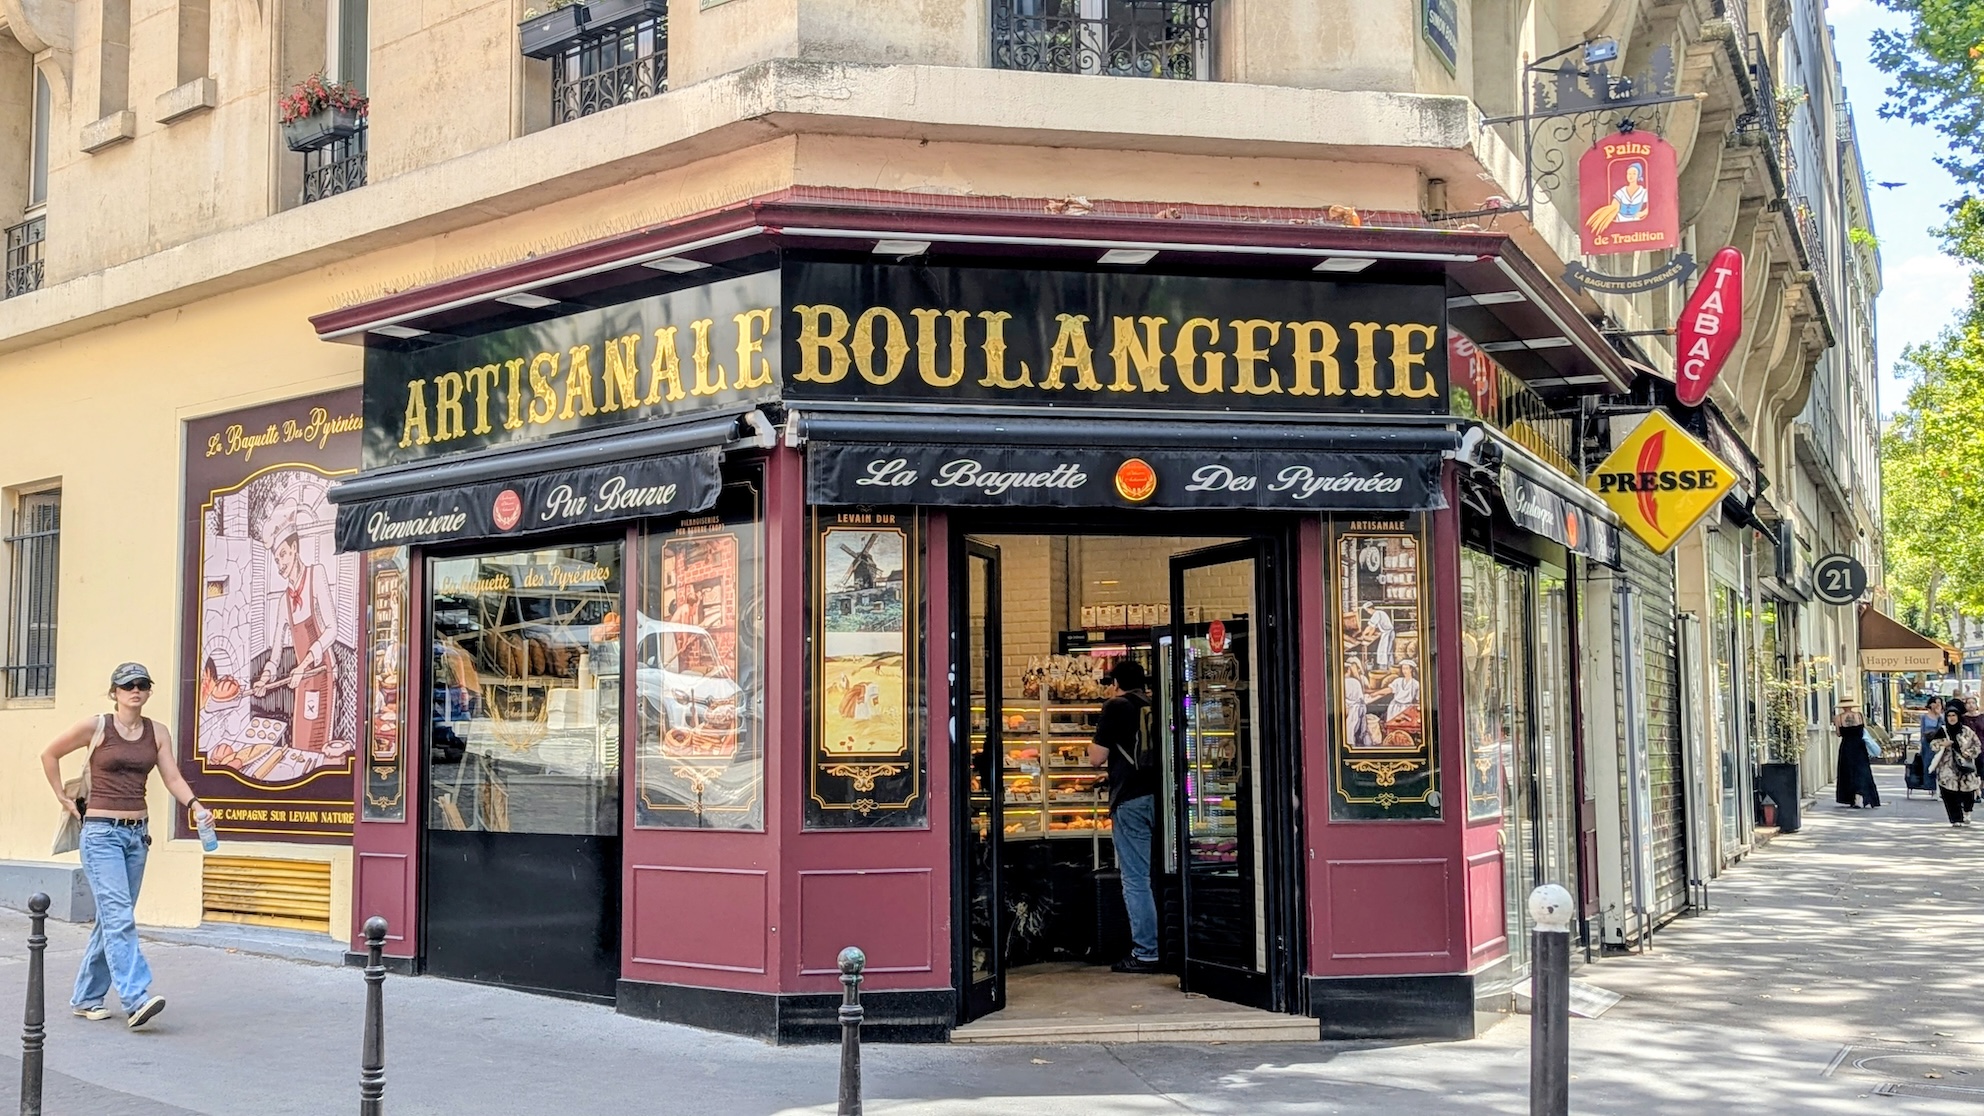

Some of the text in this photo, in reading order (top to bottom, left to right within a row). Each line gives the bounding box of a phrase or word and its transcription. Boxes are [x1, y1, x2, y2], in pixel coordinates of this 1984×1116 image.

[1603, 141, 1651, 159] Pains
[1593, 231, 1664, 246] de Tradition
[1574, 271, 1585, 281] LA
[1585, 276, 1626, 289] BAGUETTE
[1626, 280, 1643, 288] DES
[1684, 268, 1732, 381] TABAC
[791, 303, 1440, 399] BOULANGERIE
[399, 307, 773, 448] ARTISANALE
[206, 407, 364, 462] La Baguette Des Pyrénées
[856, 458, 918, 487] La
[931, 459, 1088, 496] Baguette
[1185, 463, 1257, 492] Des
[1267, 465, 1403, 499] Pyrénées
[1598, 469, 1718, 493] PRESSE
[367, 506, 467, 543] Viennoiserie
[541, 484, 587, 522] Pur
[594, 475, 677, 513] Beurre
[837, 513, 896, 524] LEVAIN DUR
[1350, 520, 1405, 531] ARTISANALE
[524, 567, 544, 588] des
[548, 562, 610, 592] Pyrénées
[1825, 568, 1852, 590] 21
[1866, 656, 1931, 667] Happy Hour
[213, 808, 224, 820] DE
[225, 808, 268, 821] CAMPAGNE
[270, 810, 287, 822] SUR
[289, 811, 318, 823] LEVAIN
